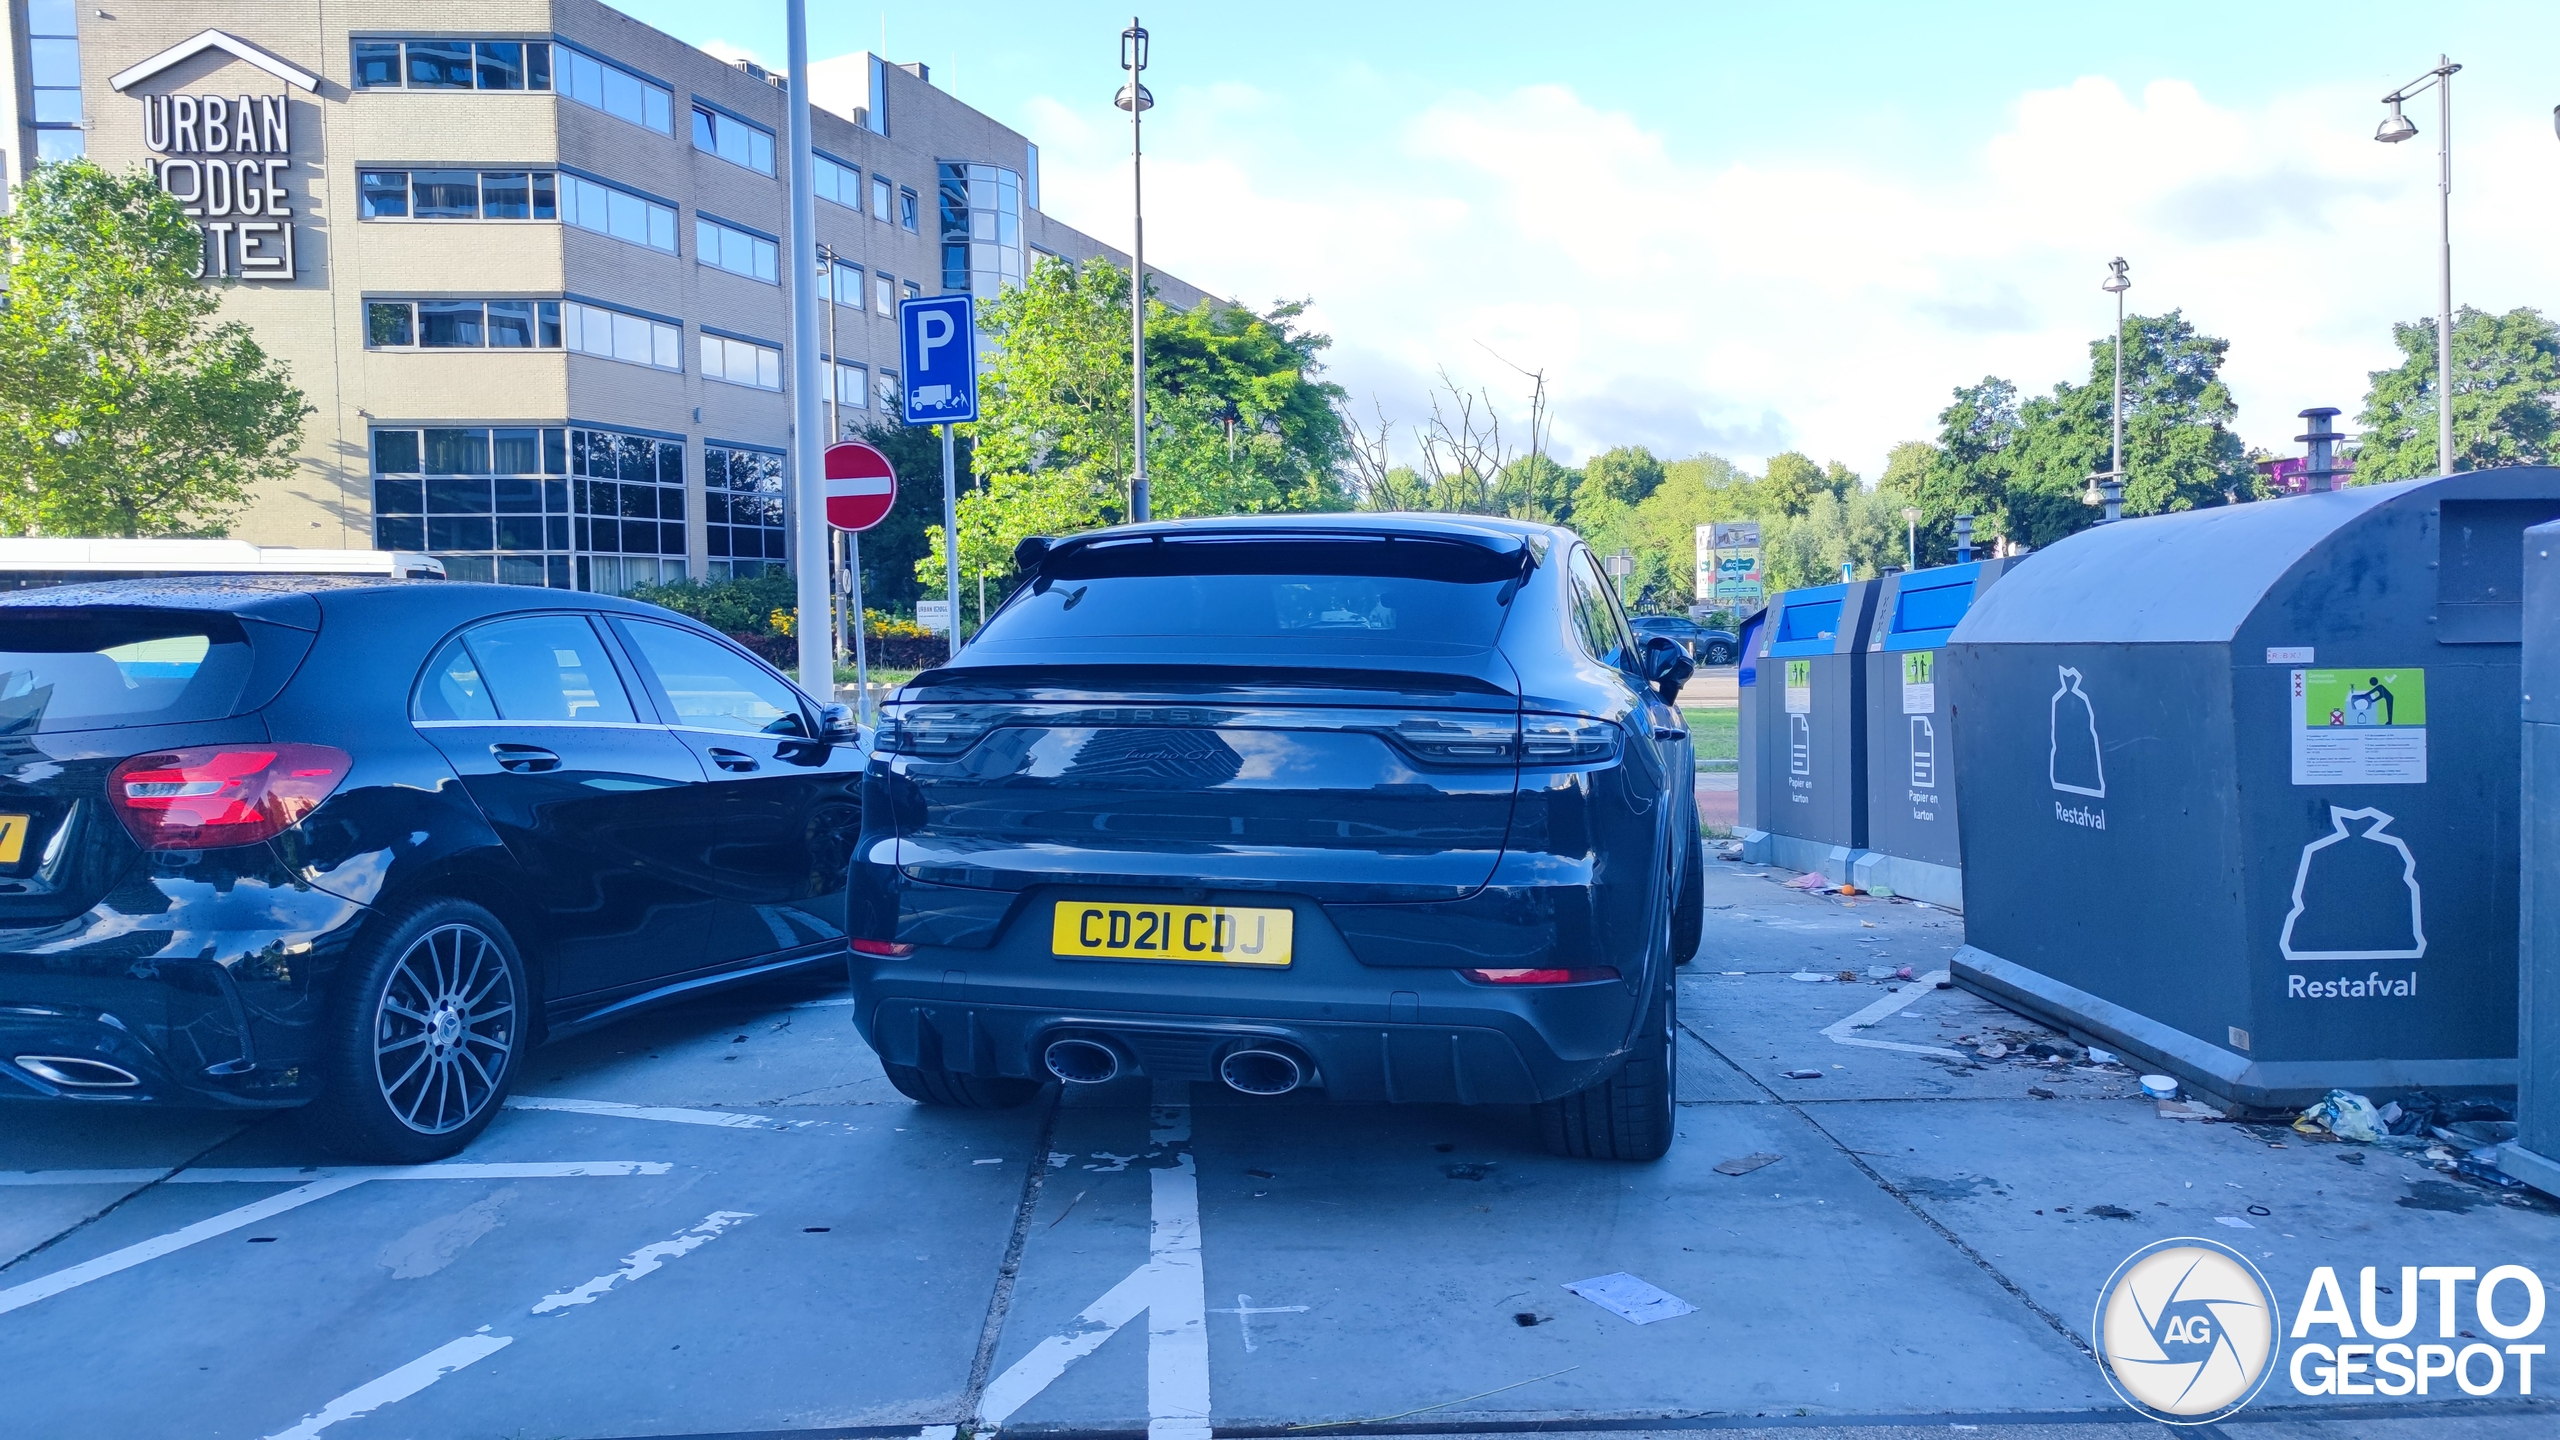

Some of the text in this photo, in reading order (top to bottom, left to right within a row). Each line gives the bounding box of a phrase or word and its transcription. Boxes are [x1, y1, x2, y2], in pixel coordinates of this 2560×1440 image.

[143, 94, 290, 153] URBAN
[183, 221, 296, 280] TEL
[917, 309, 955, 372] P
[1124, 750, 1223, 760] Turbo GT
[1788, 776, 1813, 790] Papier en
[1792, 791, 1809, 804] karton
[1908, 789, 1939, 805] Papier en
[1913, 806, 1934, 821] karton
[2055, 801, 2106, 830] Restafval
[1079, 909, 1266, 956] CD21 CDJ
[2288, 971, 2417, 998] Restafval
